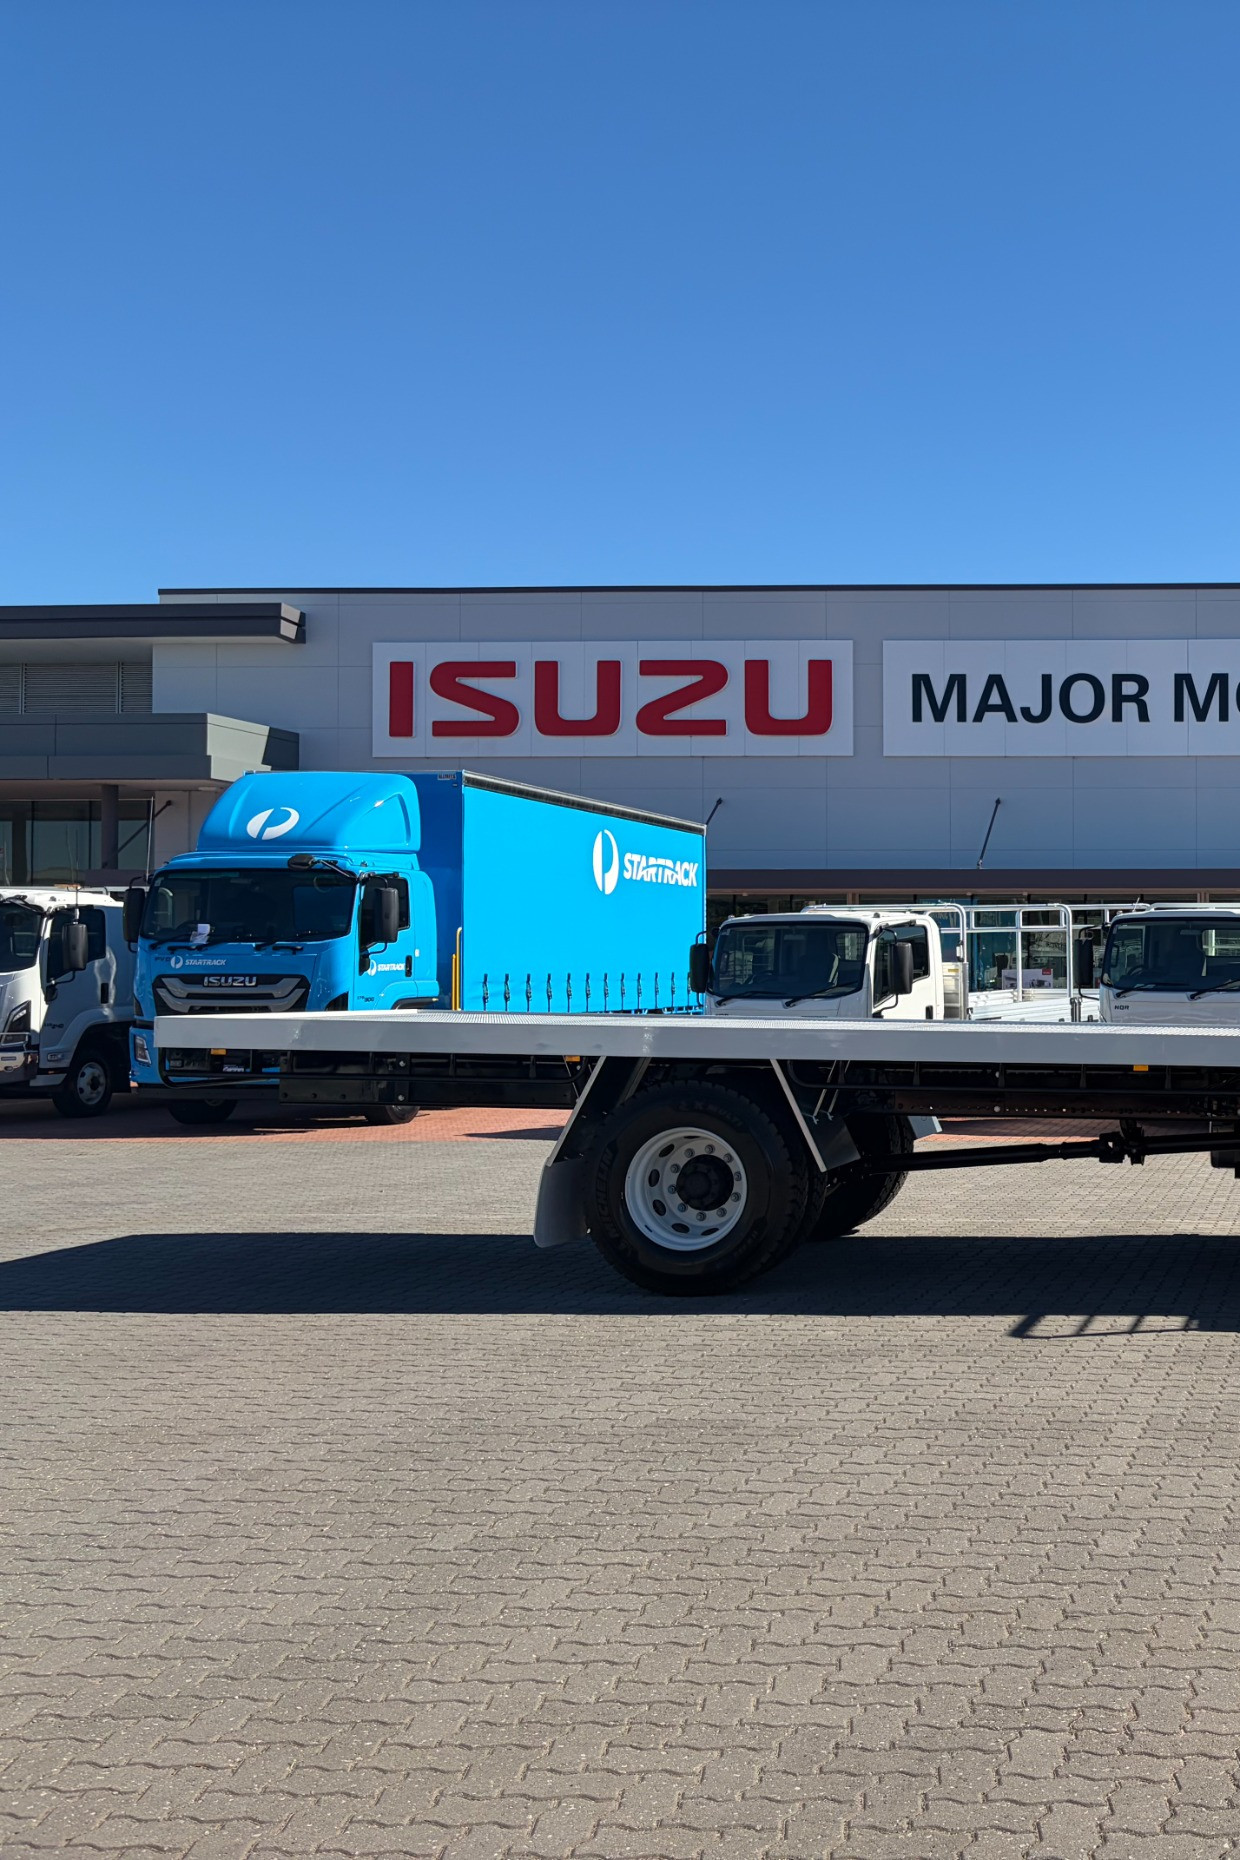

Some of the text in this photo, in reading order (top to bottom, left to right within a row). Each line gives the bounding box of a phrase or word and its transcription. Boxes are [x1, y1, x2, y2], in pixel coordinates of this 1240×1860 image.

[389, 659, 833, 737] ISUZU
[911, 673, 1150, 723] MAJOR
[623, 852, 699, 887] STARTRACK
[203, 976, 257, 987] ISUZU
